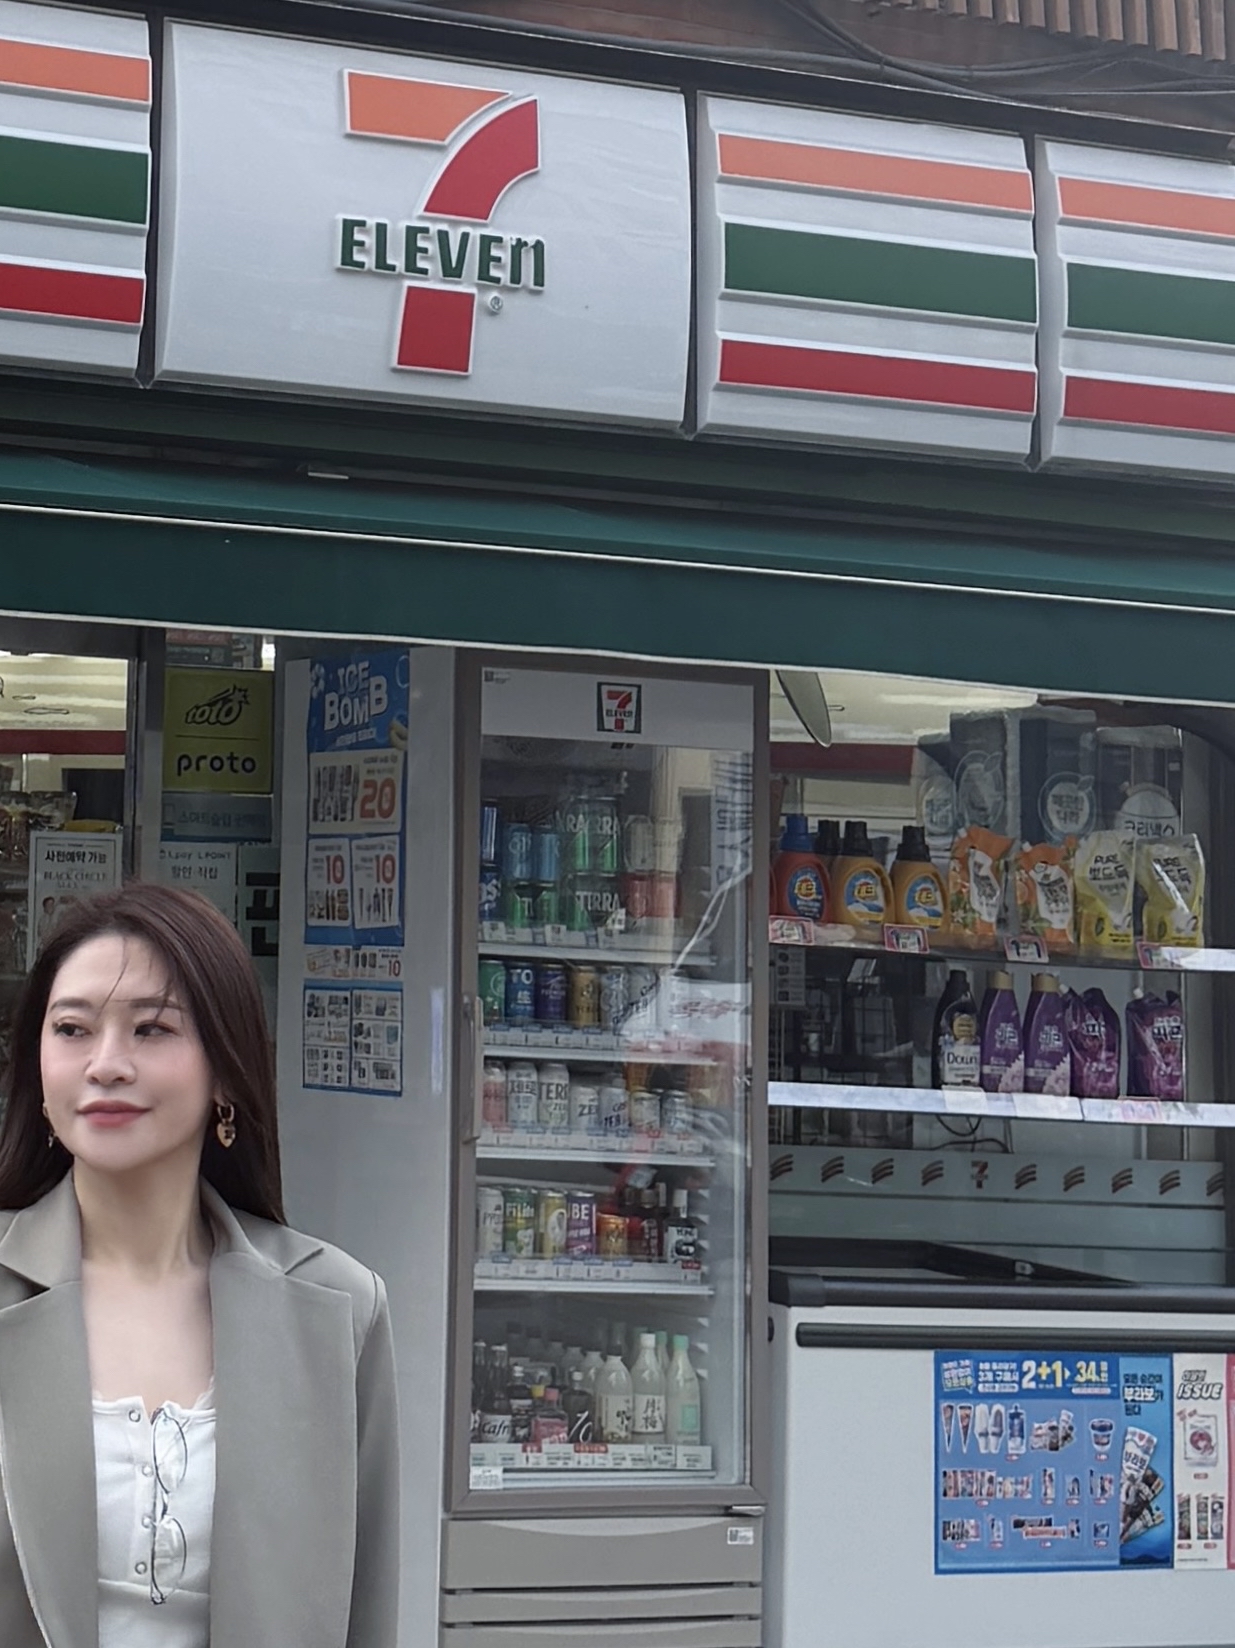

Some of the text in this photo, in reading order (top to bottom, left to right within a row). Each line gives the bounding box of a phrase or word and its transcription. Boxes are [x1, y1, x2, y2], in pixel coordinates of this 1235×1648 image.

[344, 69, 540, 375] 7
[337, 661, 370, 695] ICE
[324, 675, 388, 731] BOMB
[177, 752, 256, 776] proto
[359, 777, 396, 819] 20
[326, 854, 345, 885] 10
[375, 853, 396, 884] 10
[1021, 1360, 1063, 1389] 2+1
[1177, 1383, 1223, 1400] ISSUE
